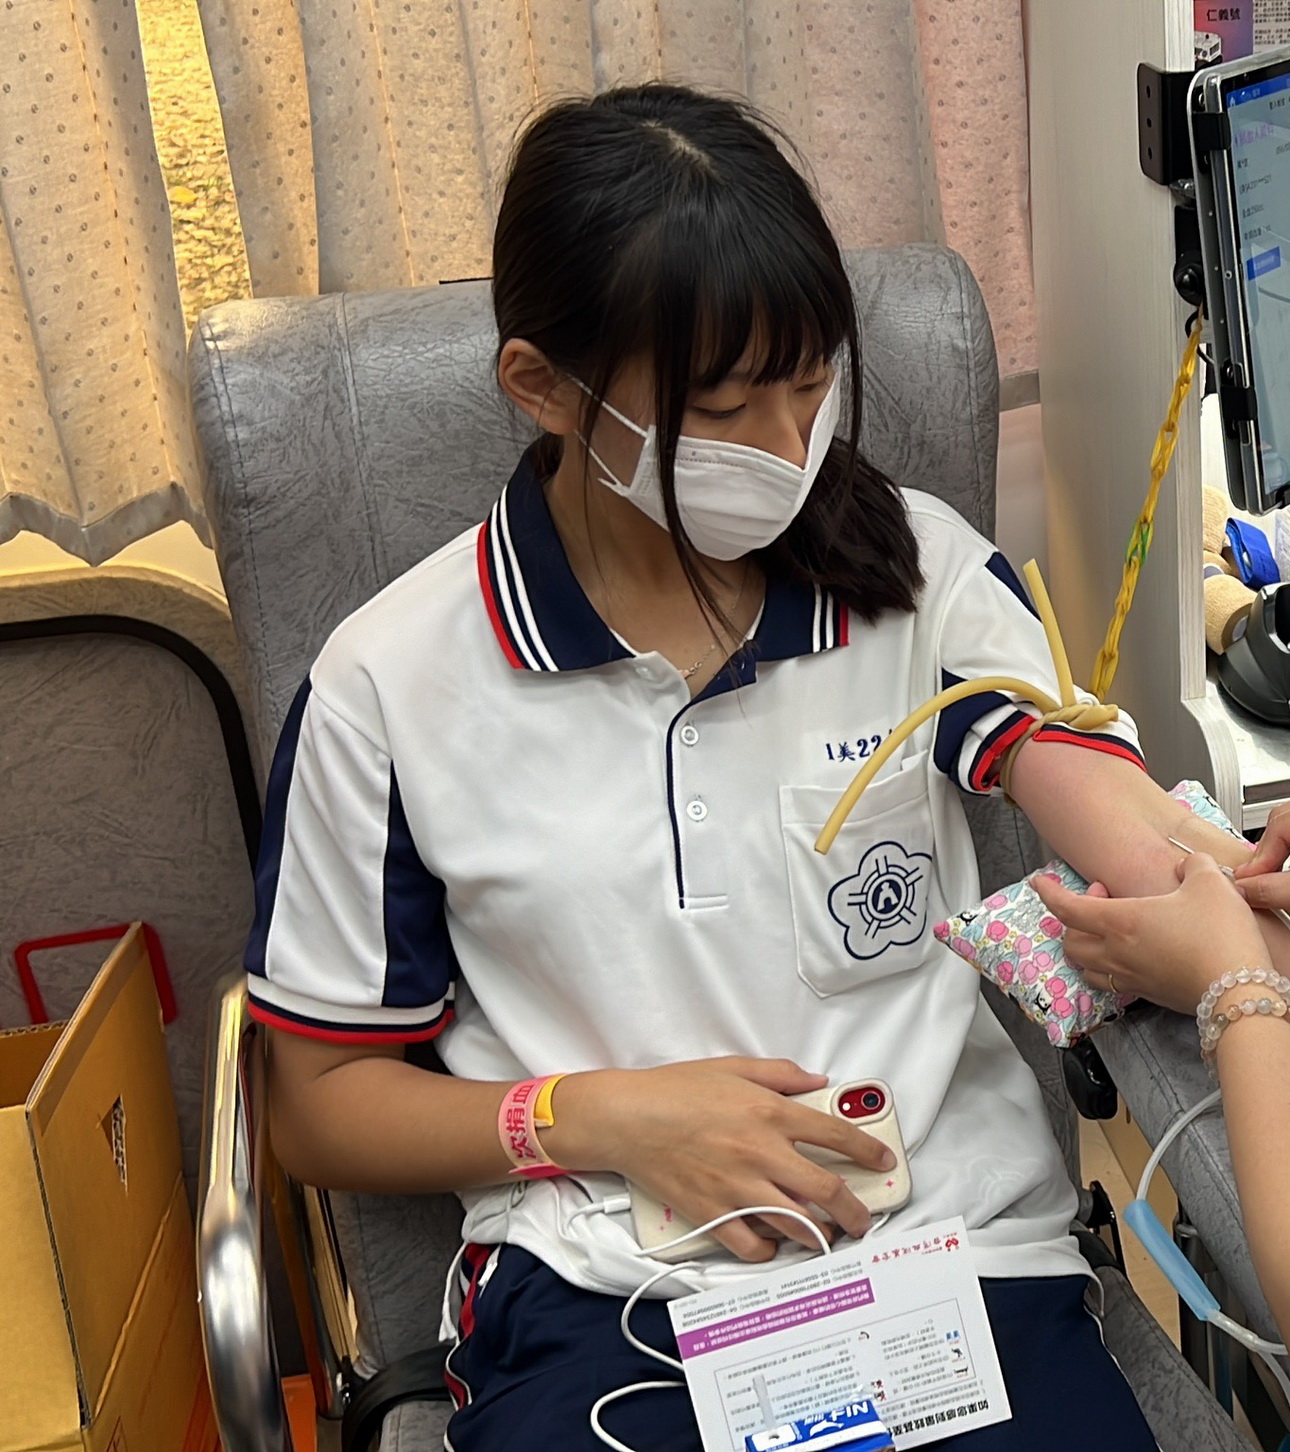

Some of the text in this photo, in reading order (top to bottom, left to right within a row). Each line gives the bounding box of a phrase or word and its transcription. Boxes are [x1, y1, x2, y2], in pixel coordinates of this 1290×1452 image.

[1207, 8, 1241, 22] 仁義號
[825, 728, 893, 762] 1美22
[829, 1400, 869, 1423] FIN
[889, 1399, 989, 1437] 如果您感到暈眩甚至
